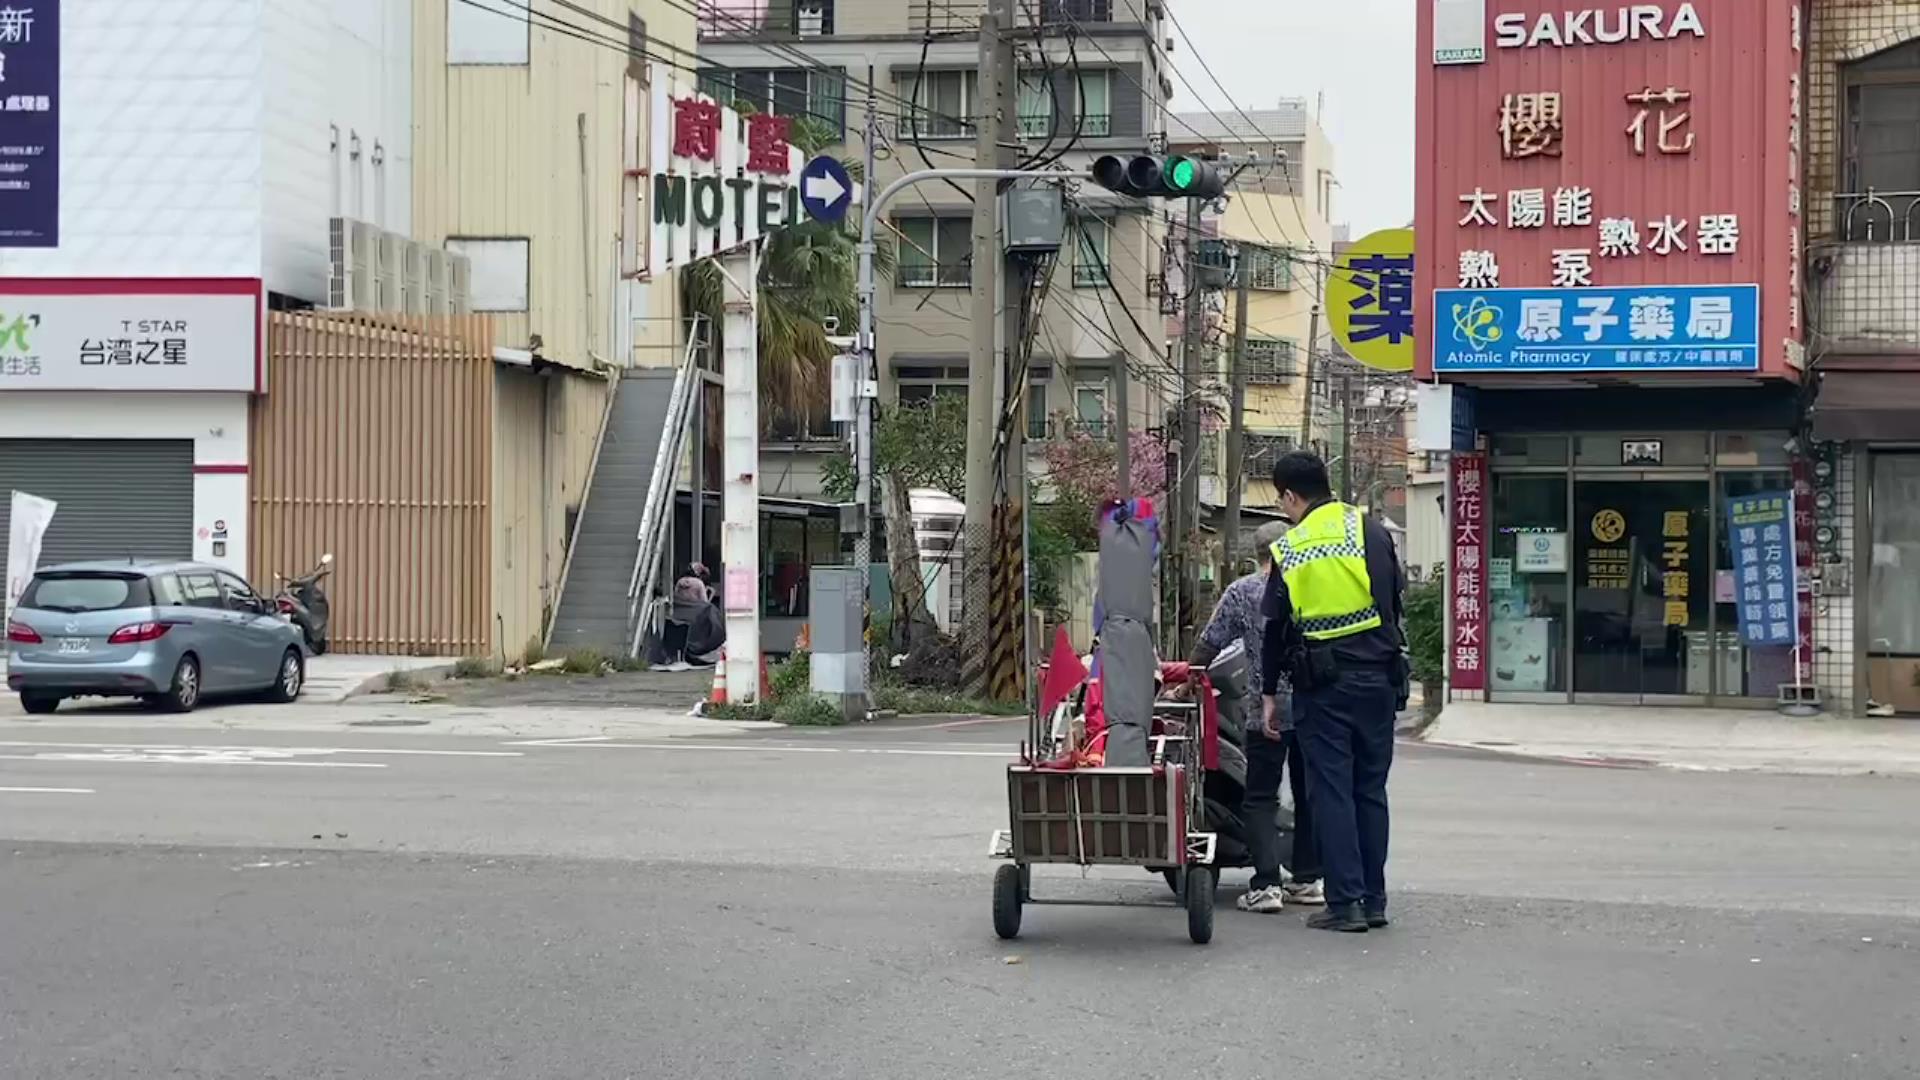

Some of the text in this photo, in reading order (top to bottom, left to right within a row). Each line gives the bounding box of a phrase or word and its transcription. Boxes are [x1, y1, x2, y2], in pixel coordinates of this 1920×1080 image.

[1495, 3, 1704, 47] SAKURA
[1436, 49, 1483, 60] SAKURA
[1498, 86, 1695, 158] 櫻花
[1458, 186, 1594, 228] 太陽能
[1599, 214, 1740, 257] 熱水器
[1458, 248, 1594, 289] 熱泵
[138, 320, 187, 333] STAR
[1516, 295, 1733, 341] 原子藥局
[0, 356, 41, 376] 生活
[1446, 350, 1591, 366] Atomic Pharmacy
[1456, 470, 1481, 670] 櫻花太陽能熱水器
[1661, 511, 1689, 627] 原子藥局
